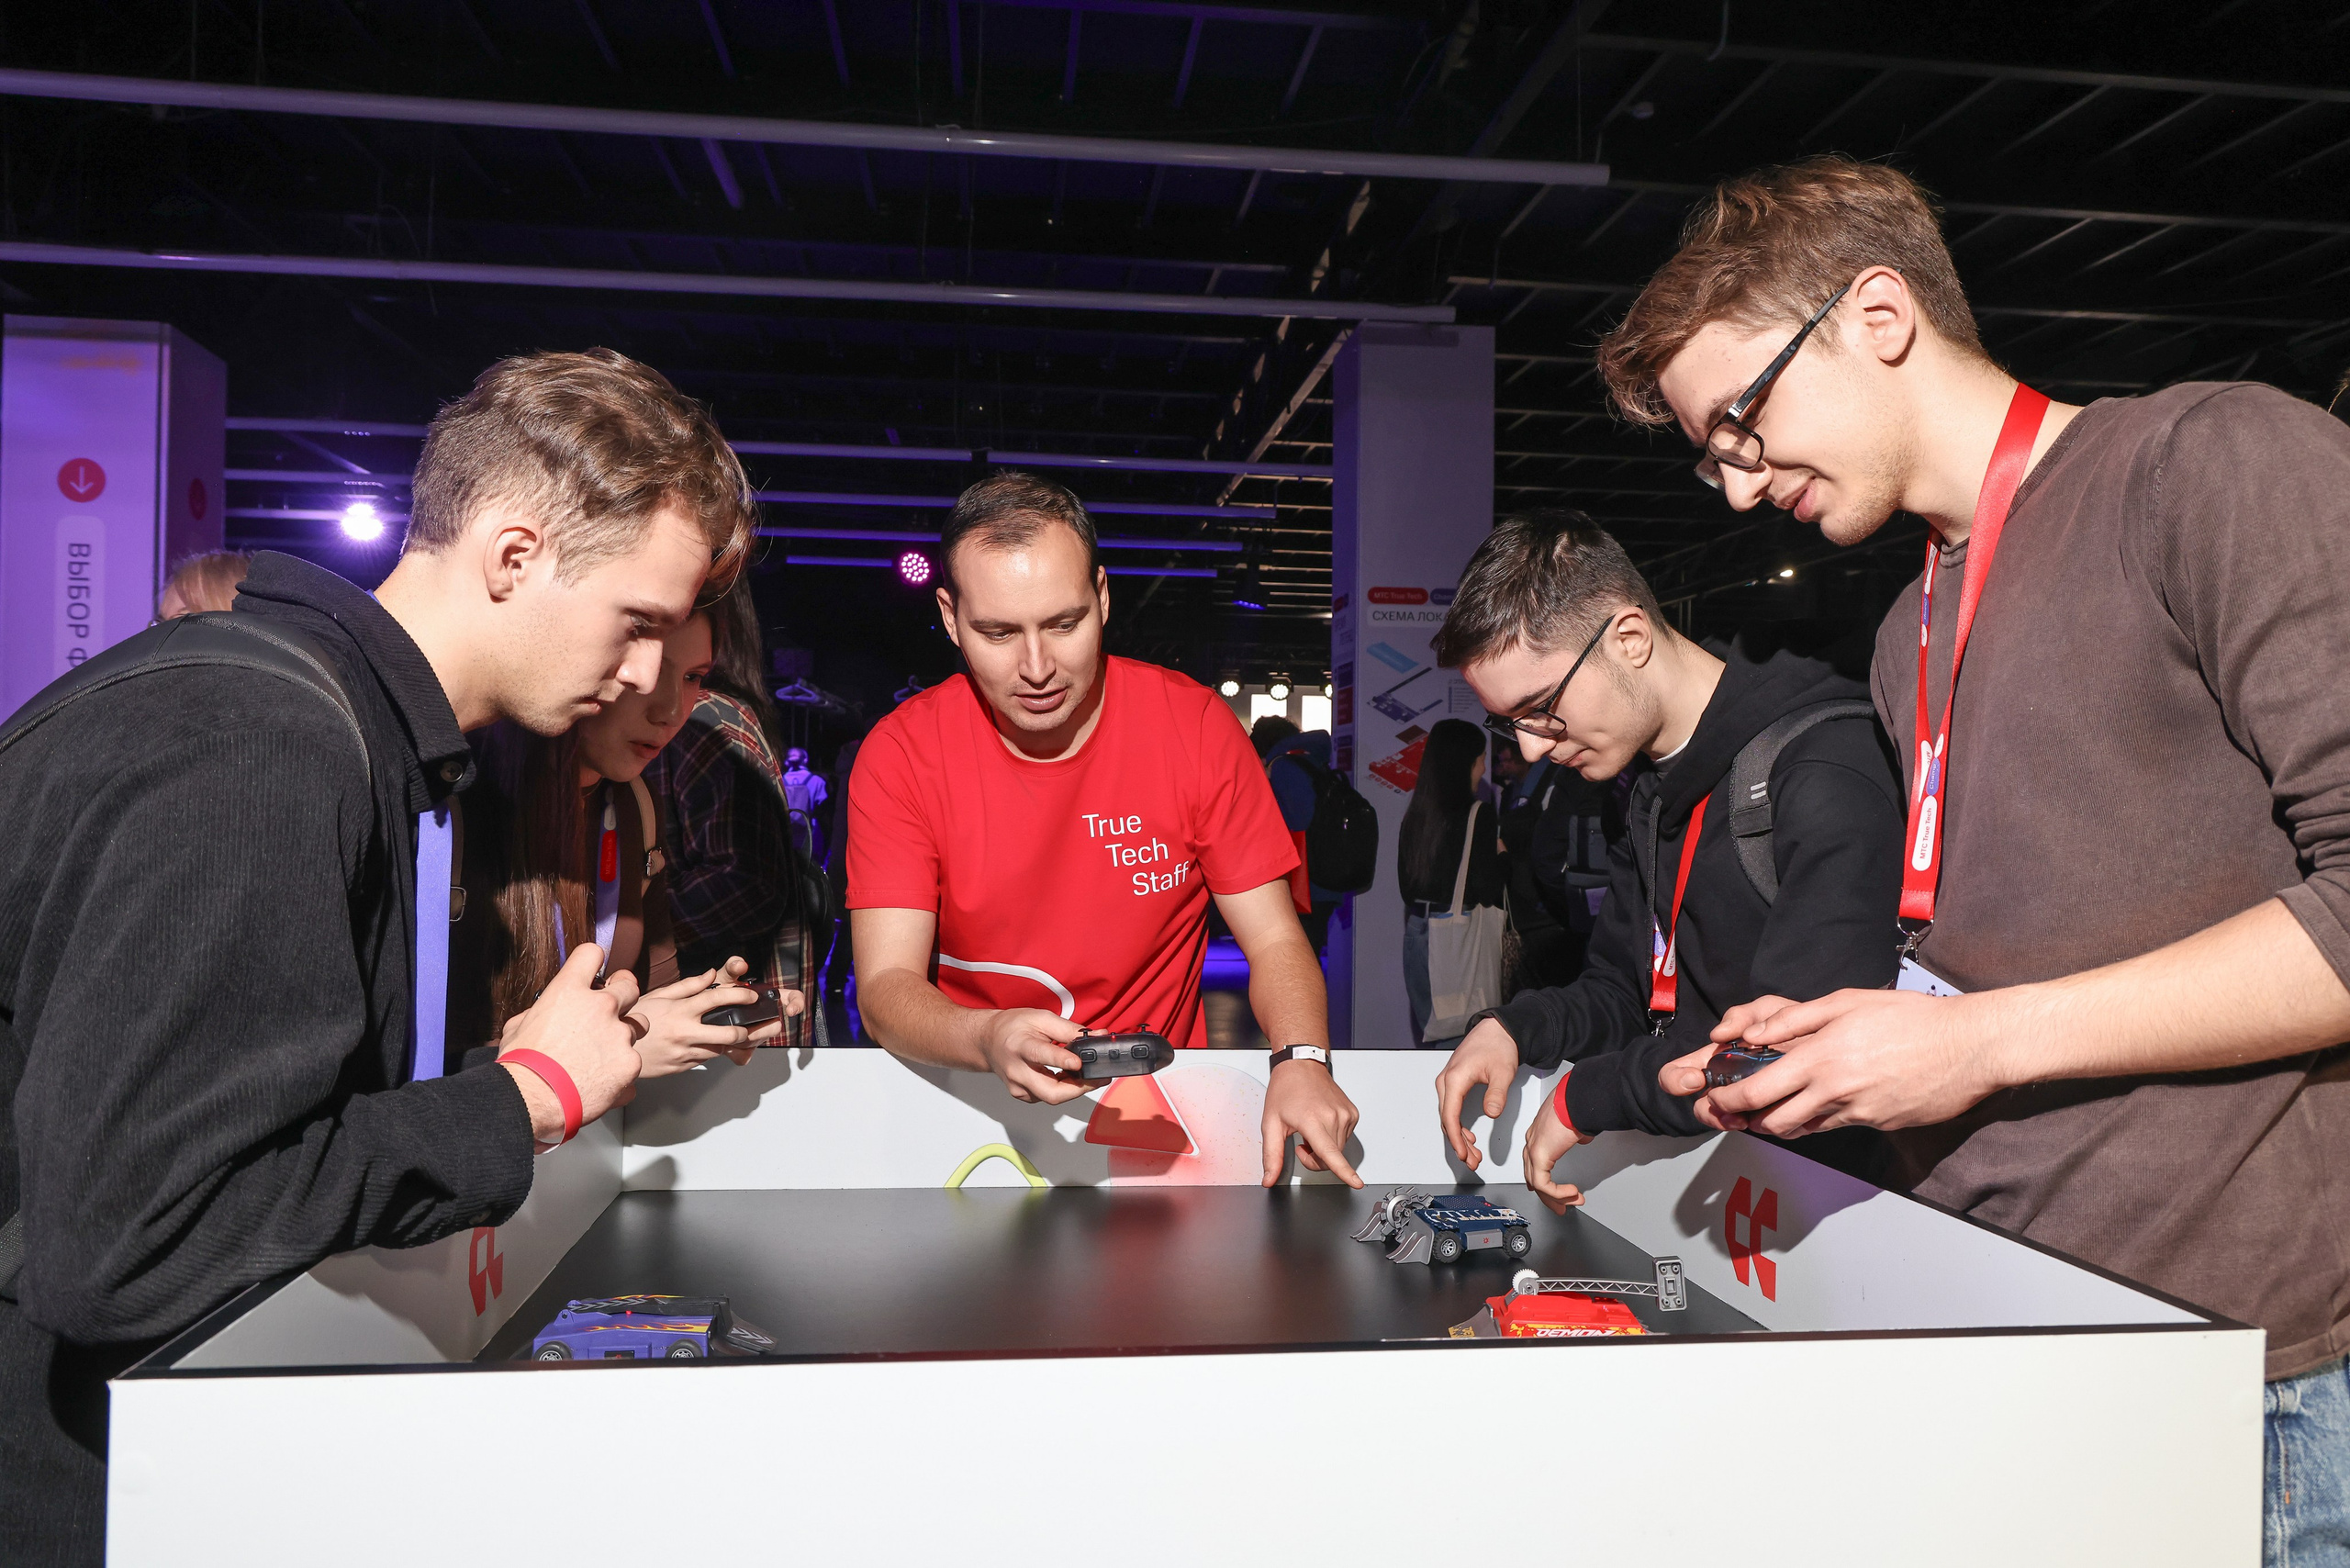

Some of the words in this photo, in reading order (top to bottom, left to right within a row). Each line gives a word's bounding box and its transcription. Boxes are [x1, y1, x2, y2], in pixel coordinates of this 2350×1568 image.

[66, 542, 91, 639] ВЫБОР
[1372, 610, 1415, 622] СХЕМА
[65, 646, 88, 668] Ф
[1929, 763, 1937, 790] Champ
[1081, 813, 1142, 838] True
[1922, 825, 1930, 842] True
[1104, 837, 1169, 868] Tech
[1132, 861, 1189, 896] Staff
[1536, 1328, 1617, 1338] DEMON
